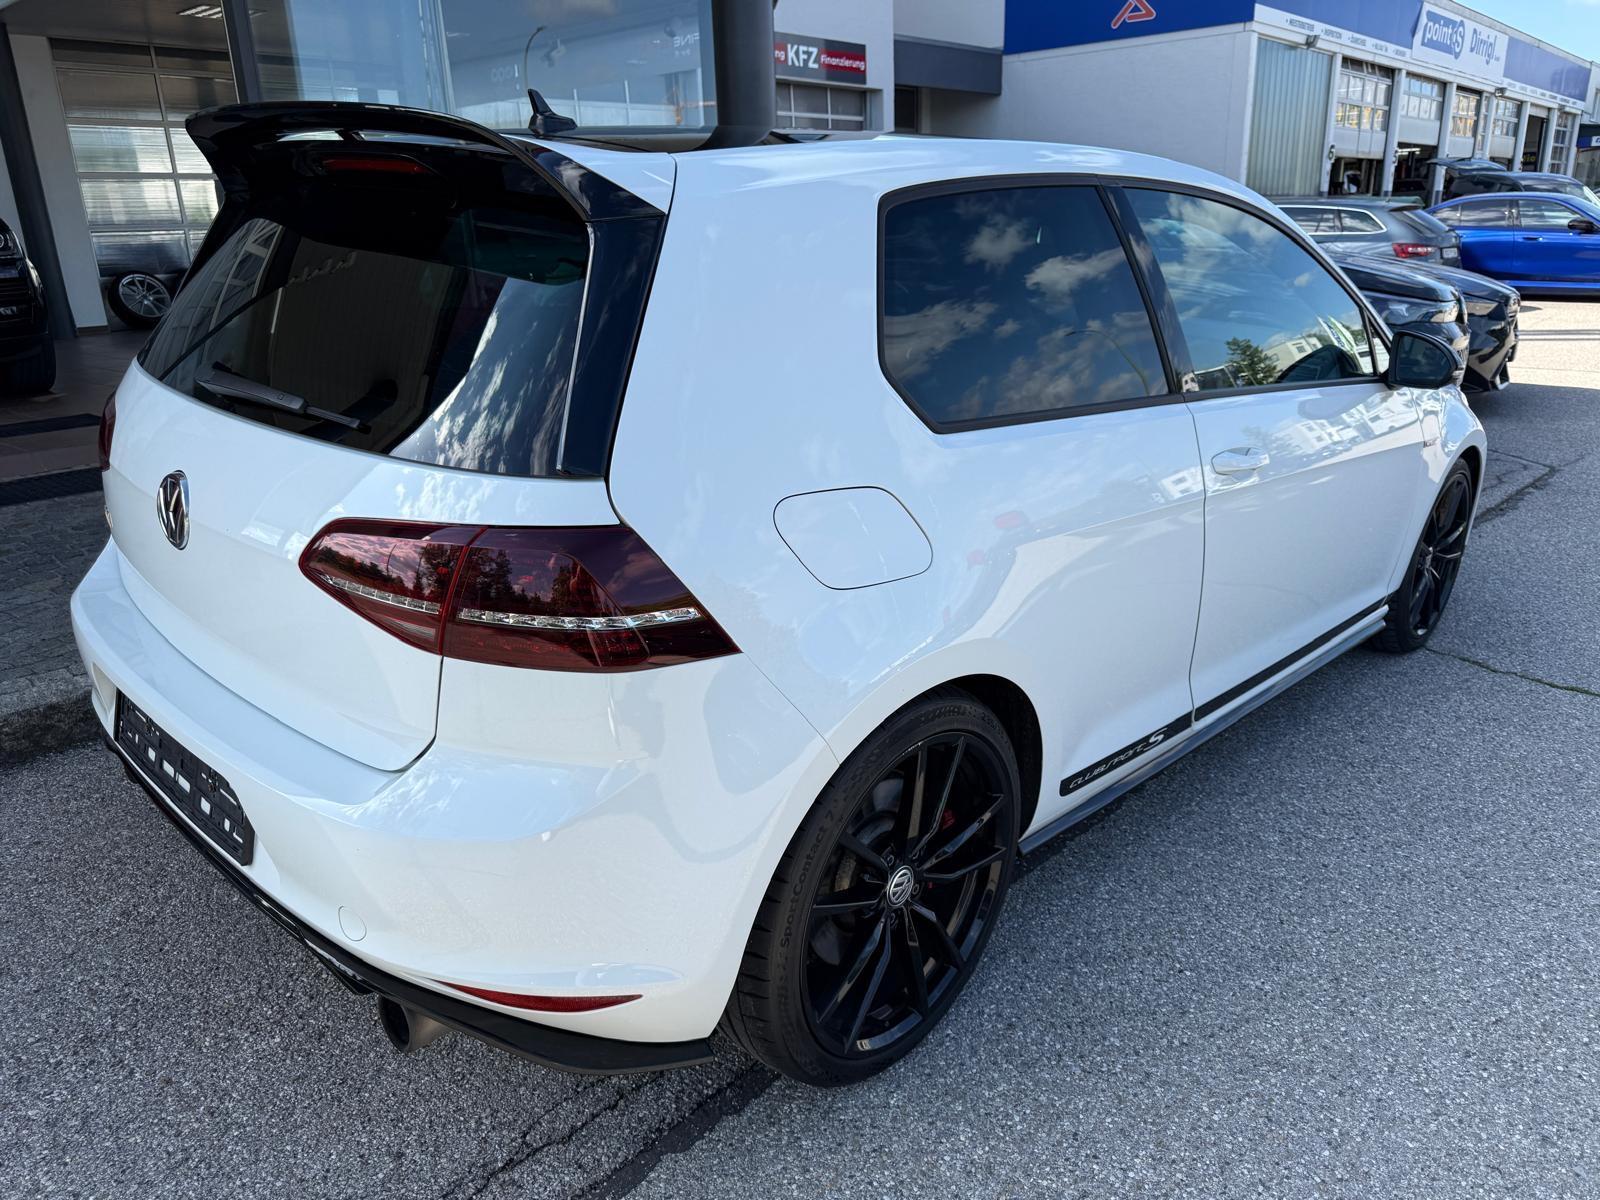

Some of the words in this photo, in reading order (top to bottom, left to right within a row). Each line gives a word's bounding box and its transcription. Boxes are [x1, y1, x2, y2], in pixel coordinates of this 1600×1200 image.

[1424, 20, 1451, 44] point
[787, 44, 819, 69] KFZ
[820, 54, 865, 71] Finanzierung
[781, 825, 827, 948] SportContact
